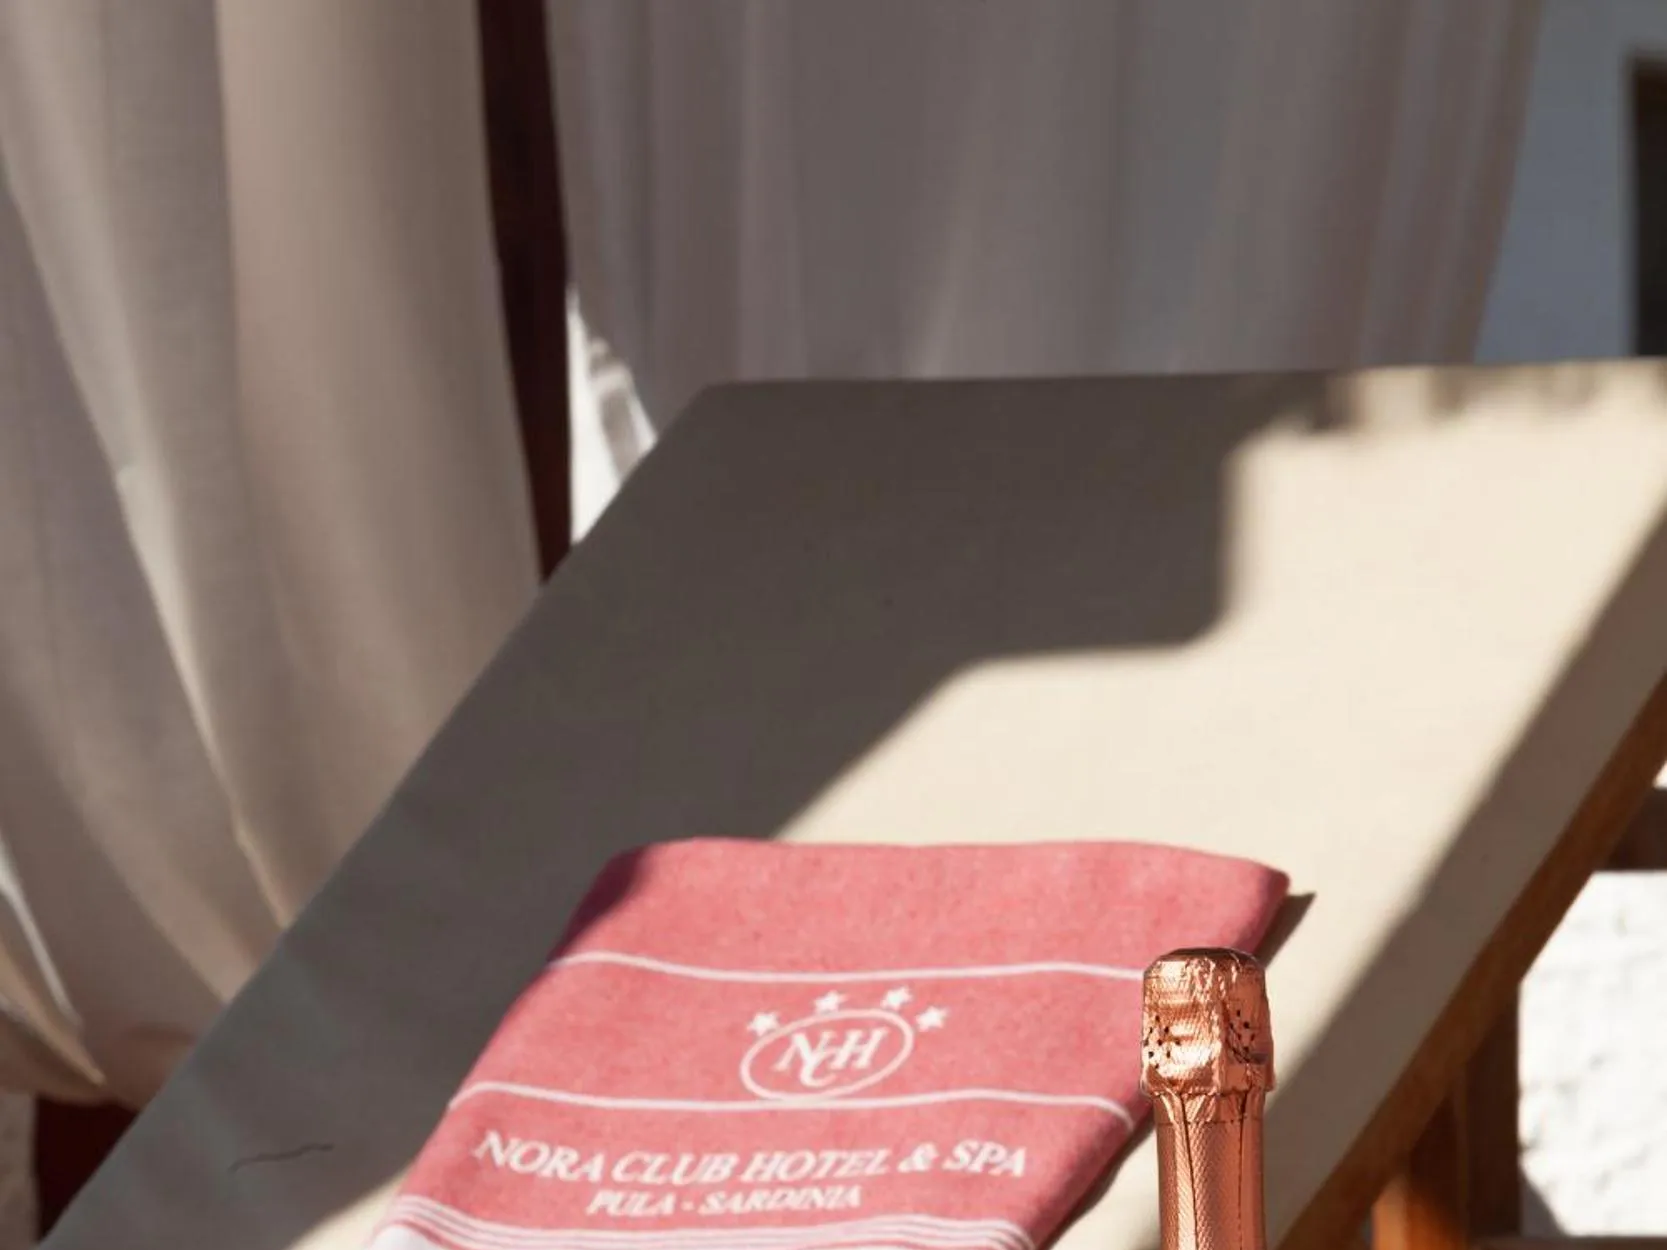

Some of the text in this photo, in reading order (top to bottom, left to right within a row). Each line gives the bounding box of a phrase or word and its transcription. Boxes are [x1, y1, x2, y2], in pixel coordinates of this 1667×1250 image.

[474, 1130, 1026, 1186] NORA CLUB HOTEL & SPA
[586, 1189, 676, 1217] PULA
[697, 1184, 862, 1214] SARDINIA
